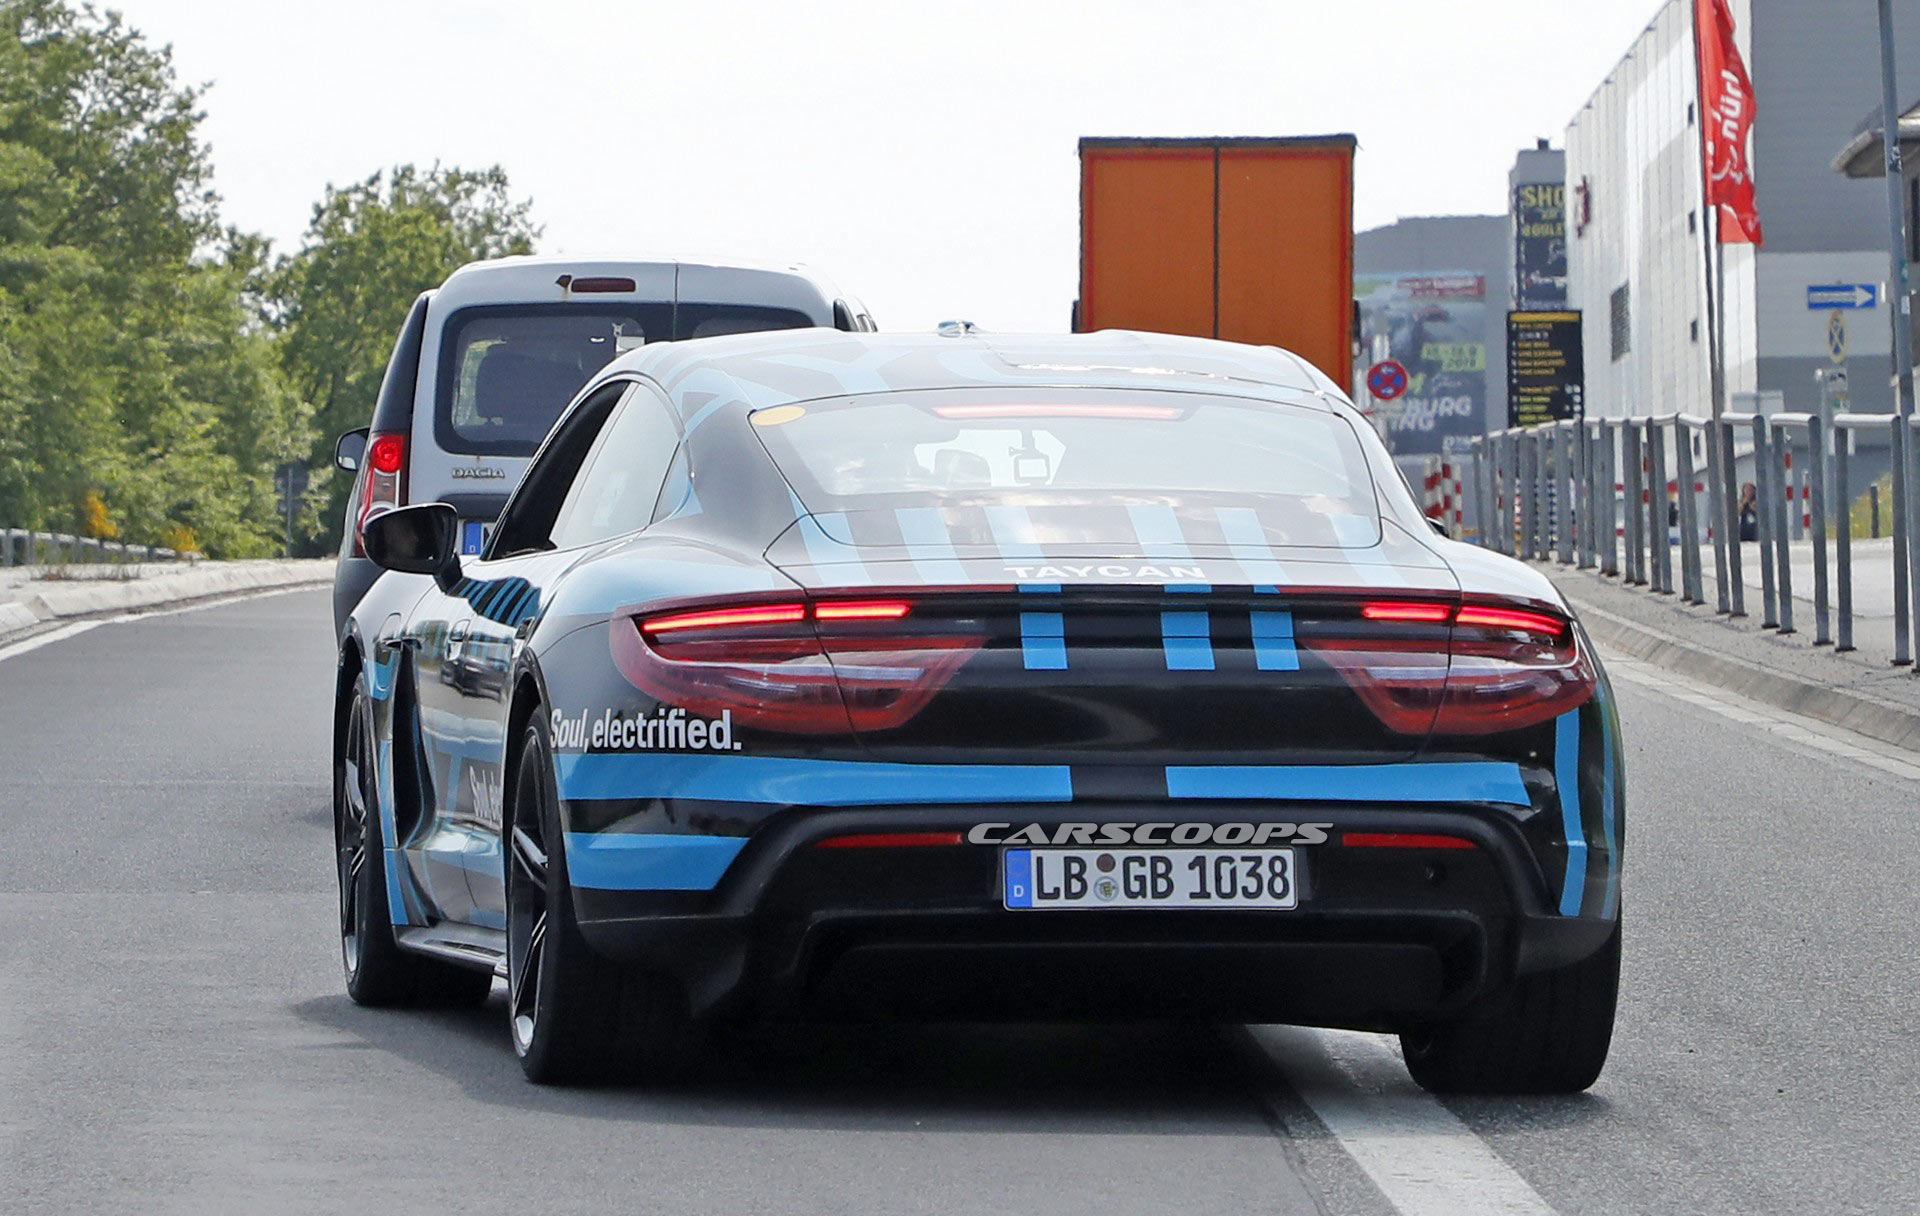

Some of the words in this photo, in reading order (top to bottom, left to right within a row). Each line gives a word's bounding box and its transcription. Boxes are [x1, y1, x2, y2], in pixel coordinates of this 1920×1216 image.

[452, 467, 505, 478] DACIA
[1003, 565, 1206, 578] TAYCAN
[550, 708, 589, 753] Soul,
[592, 708, 743, 751] electrified.
[1013, 885, 1024, 898] D
[1035, 856, 1088, 899] LB
[1123, 856, 1175, 899] GB
[1188, 856, 1289, 899] 1038
